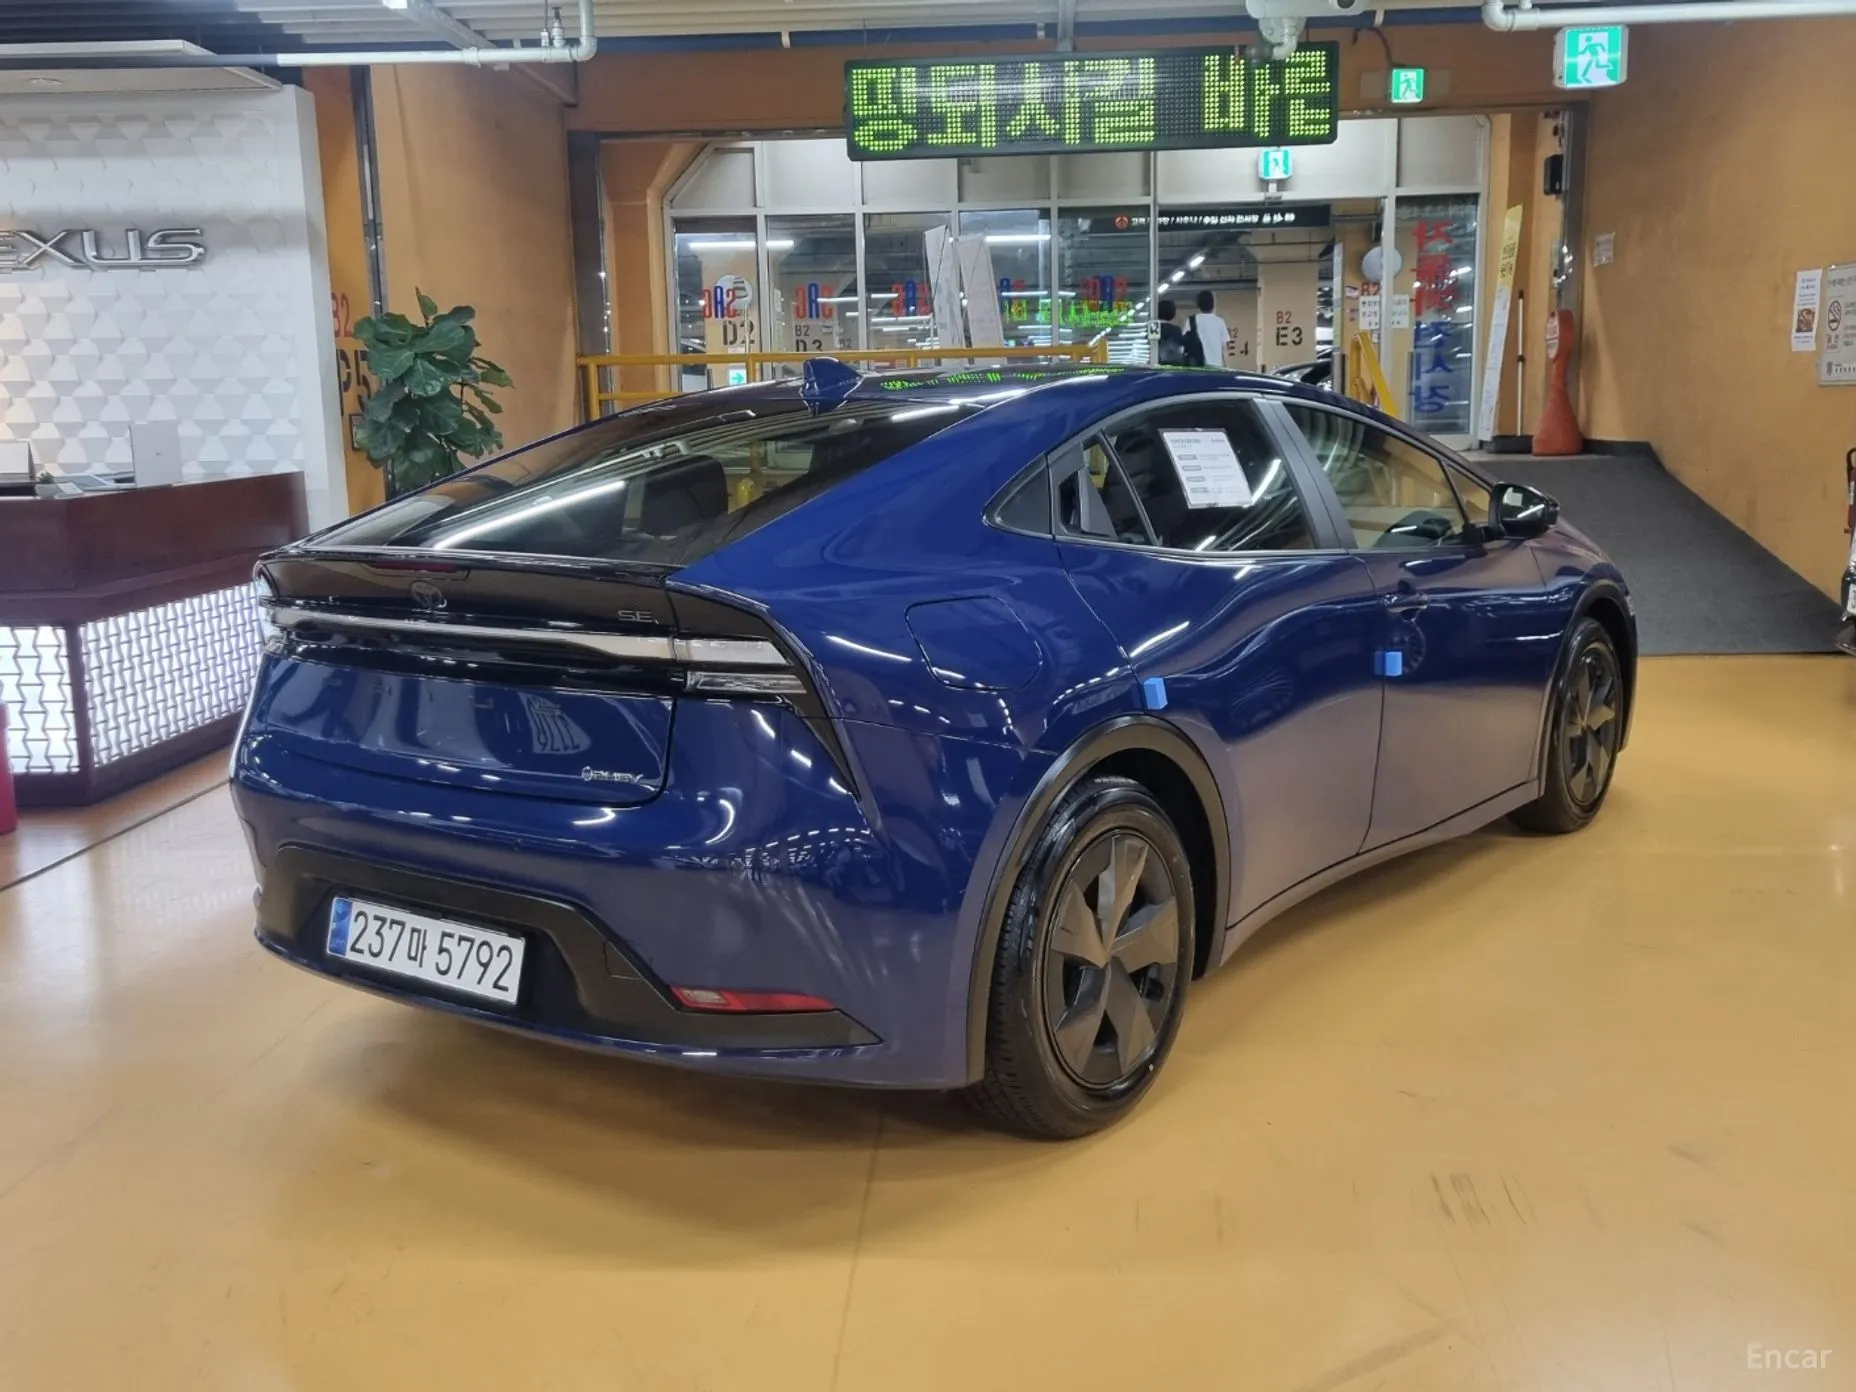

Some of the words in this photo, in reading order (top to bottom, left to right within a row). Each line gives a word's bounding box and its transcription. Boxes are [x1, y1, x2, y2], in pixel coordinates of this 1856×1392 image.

[1276, 311, 1292, 324] B2
[722, 320, 755, 346] D2
[795, 324, 810, 337] B2
[1276, 327, 1303, 346] E3
[350, 910, 428, 968] 237마
[435, 930, 513, 992] 5792
